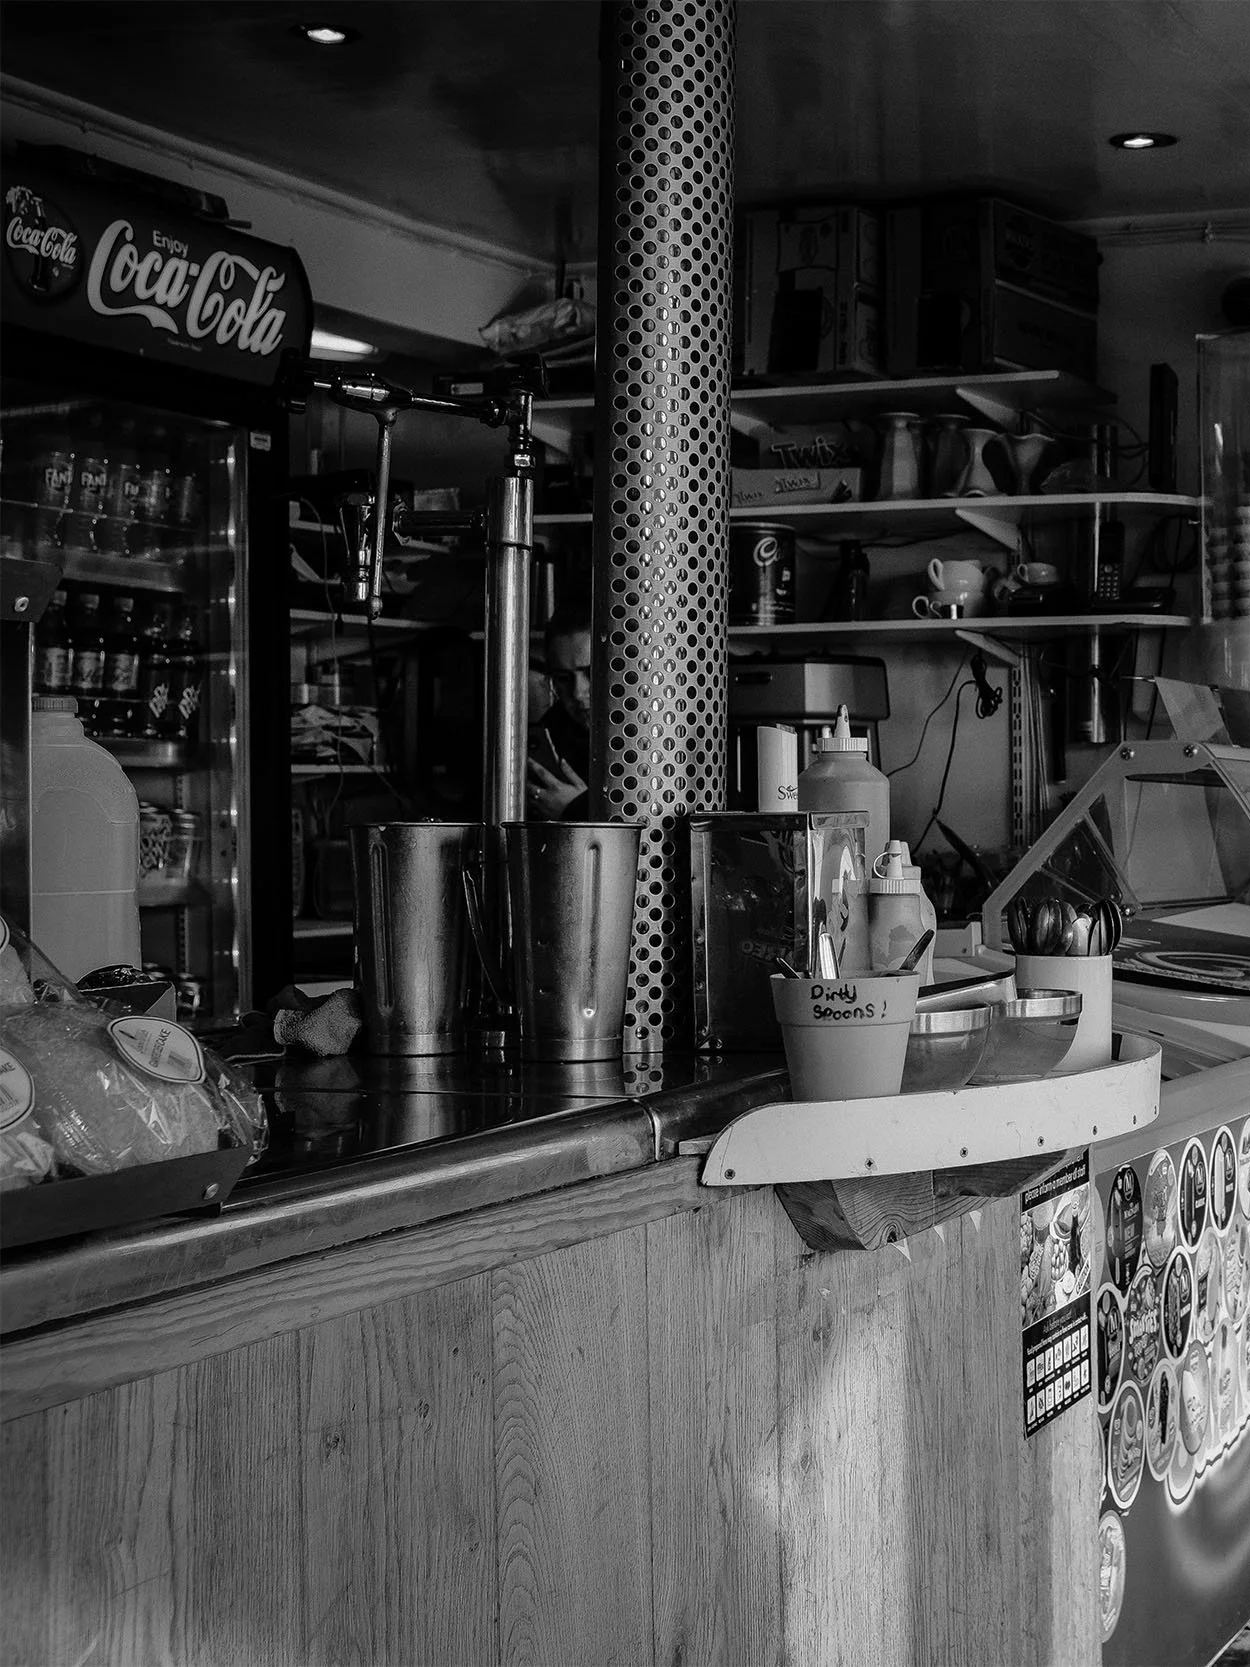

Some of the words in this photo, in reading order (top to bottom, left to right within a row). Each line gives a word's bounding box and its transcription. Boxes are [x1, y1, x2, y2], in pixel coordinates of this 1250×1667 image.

[5, 217, 78, 265] Coca-Cola
[152, 229, 189, 258] Enjoy
[87, 219, 287, 356] Coca-Cola
[810, 984, 857, 1004] Dirty
